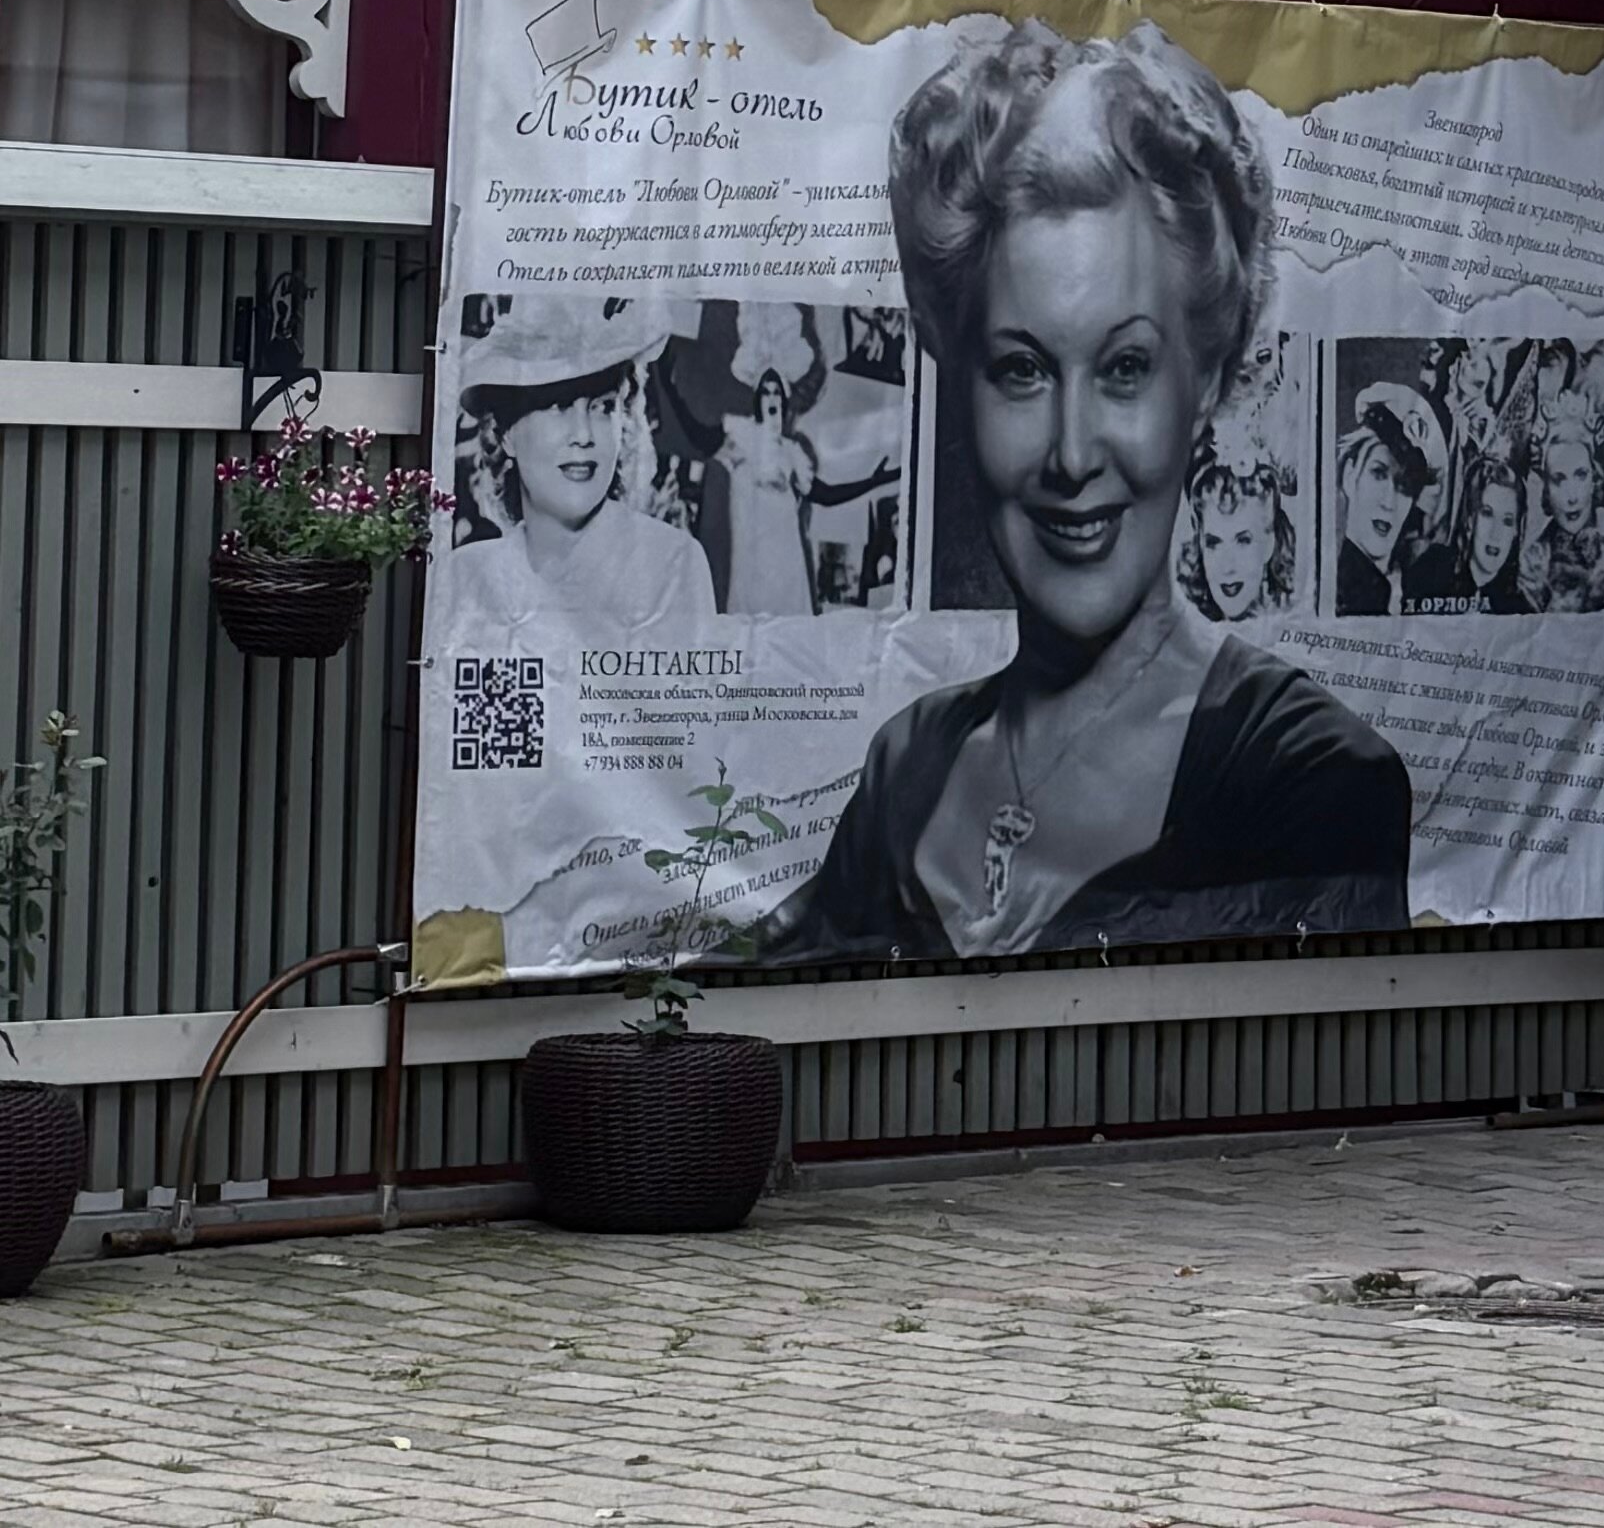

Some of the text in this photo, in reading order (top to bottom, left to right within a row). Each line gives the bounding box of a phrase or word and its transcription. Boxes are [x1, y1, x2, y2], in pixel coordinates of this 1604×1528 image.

[564, 63, 698, 119] Бутик
[730, 91, 823, 121] отель
[516, 90, 740, 152] Любови Орловой
[1302, 116, 1339, 142] Один
[1342, 131, 1358, 146] из
[1424, 109, 1504, 146] Звенигород
[1282, 147, 1378, 189] Подмосковья,
[1382, 169, 1445, 201] богатый
[486, 180, 626, 212] Бутик-отель
[634, 178, 699, 202] "Любови
[704, 177, 790, 209] Орловой"
[505, 226, 568, 242] гость
[573, 224, 689, 250] погружается
[704, 215, 808, 246] атмосферу
[497, 259, 568, 282] Отель
[573, 263, 673, 284] сохраняет
[763, 255, 837, 276] великой
[1452, 255, 1490, 280] город
[580, 650, 743, 676] КОНТАКТЫ
[687, 732, 695, 745] 2
